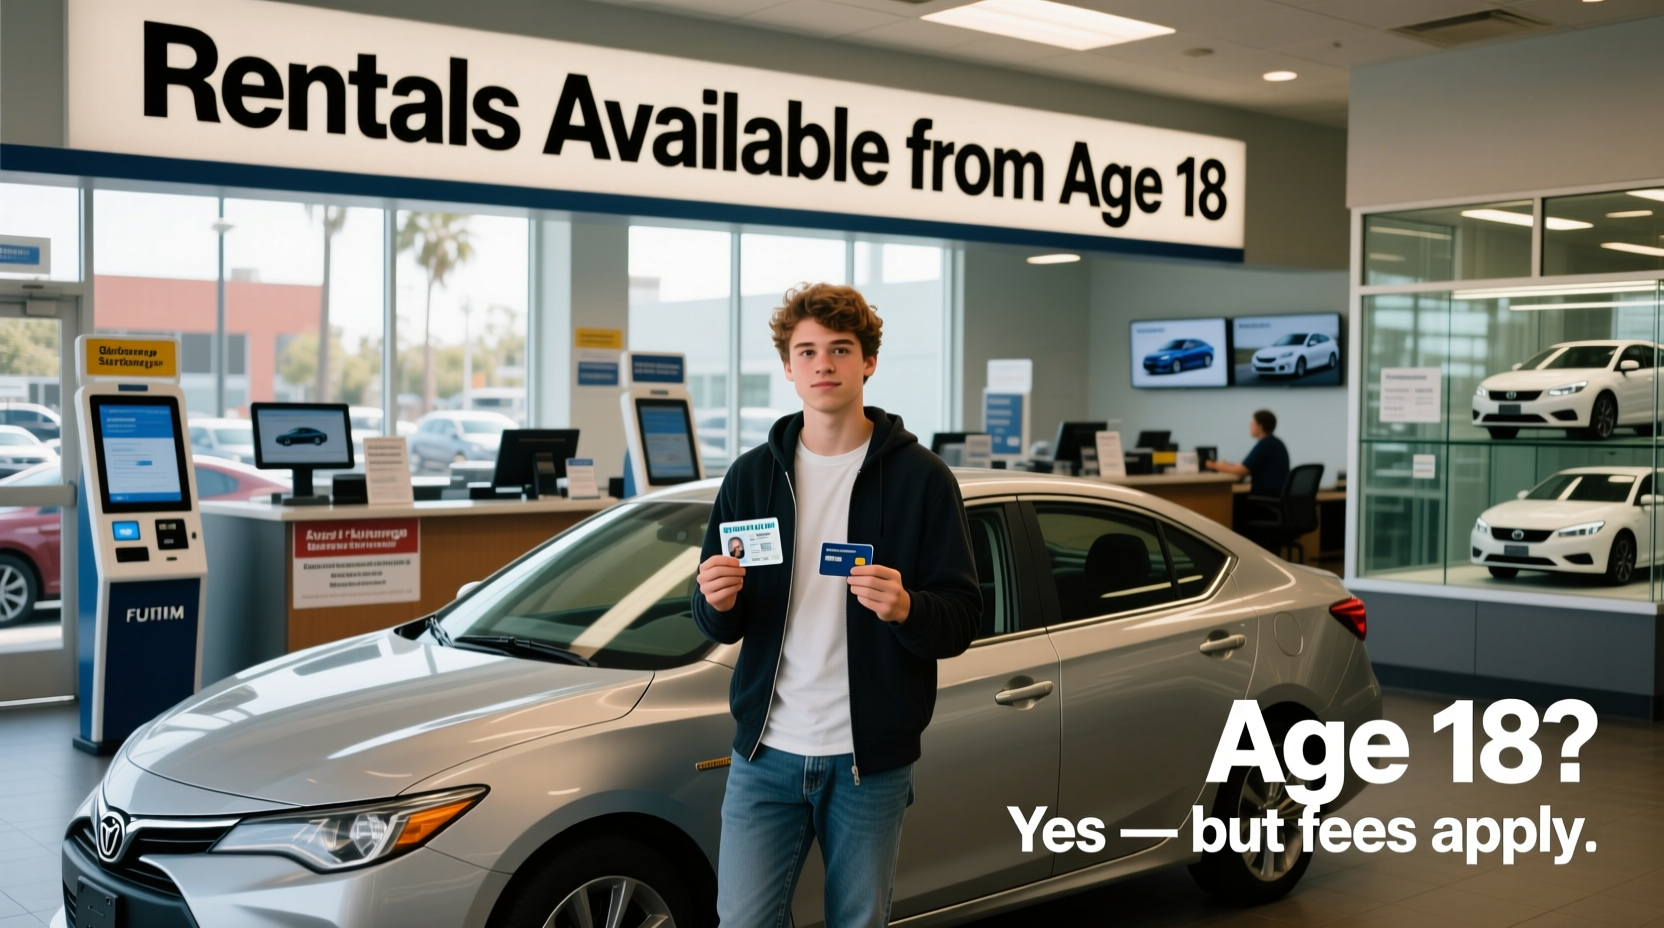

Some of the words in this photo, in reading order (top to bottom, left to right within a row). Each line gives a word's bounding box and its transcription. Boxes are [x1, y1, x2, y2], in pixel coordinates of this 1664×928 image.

[143, 20, 521, 151] Rentals
[542, 73, 889, 187] Available
[906, 118, 1044, 202] from
[1059, 142, 1163, 229] Age
[1176, 156, 1227, 221] 18
